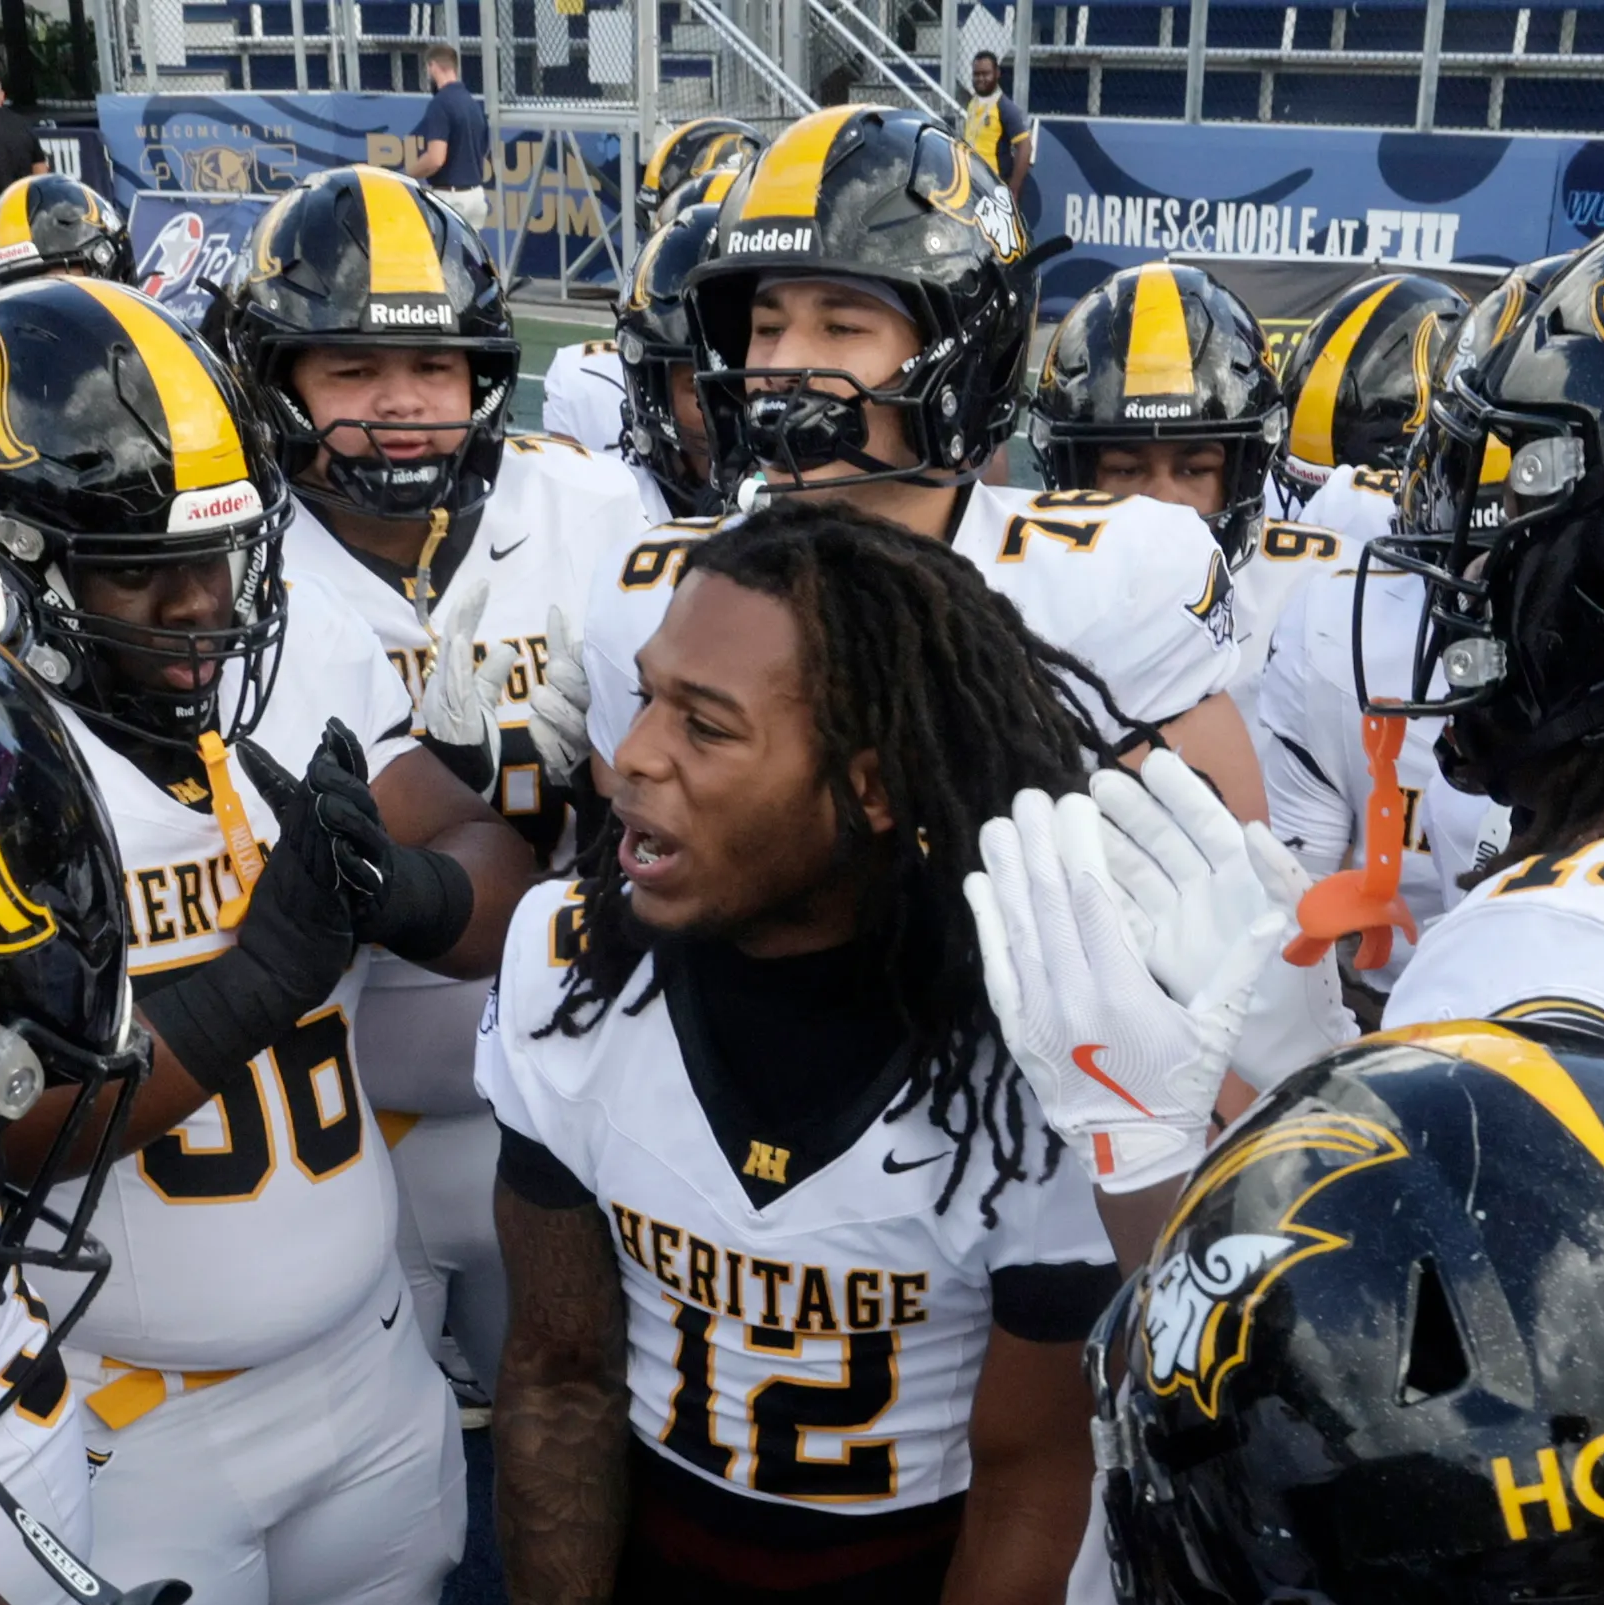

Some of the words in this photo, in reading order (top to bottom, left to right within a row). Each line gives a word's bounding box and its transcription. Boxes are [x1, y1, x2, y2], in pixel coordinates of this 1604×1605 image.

[135, 124, 220, 139] WELCOME
[231, 123, 252, 138] TO
[262, 122, 295, 138] THE
[727, 227, 812, 254] Riddell
[1323, 218, 1360, 258] AT
[1363, 208, 1460, 263] FIU
[370, 303, 453, 325] Riddell
[234, 543, 268, 617] Riddell
[609, 1200, 930, 1333] HERITAGE
[659, 1290, 902, 1504] 12
